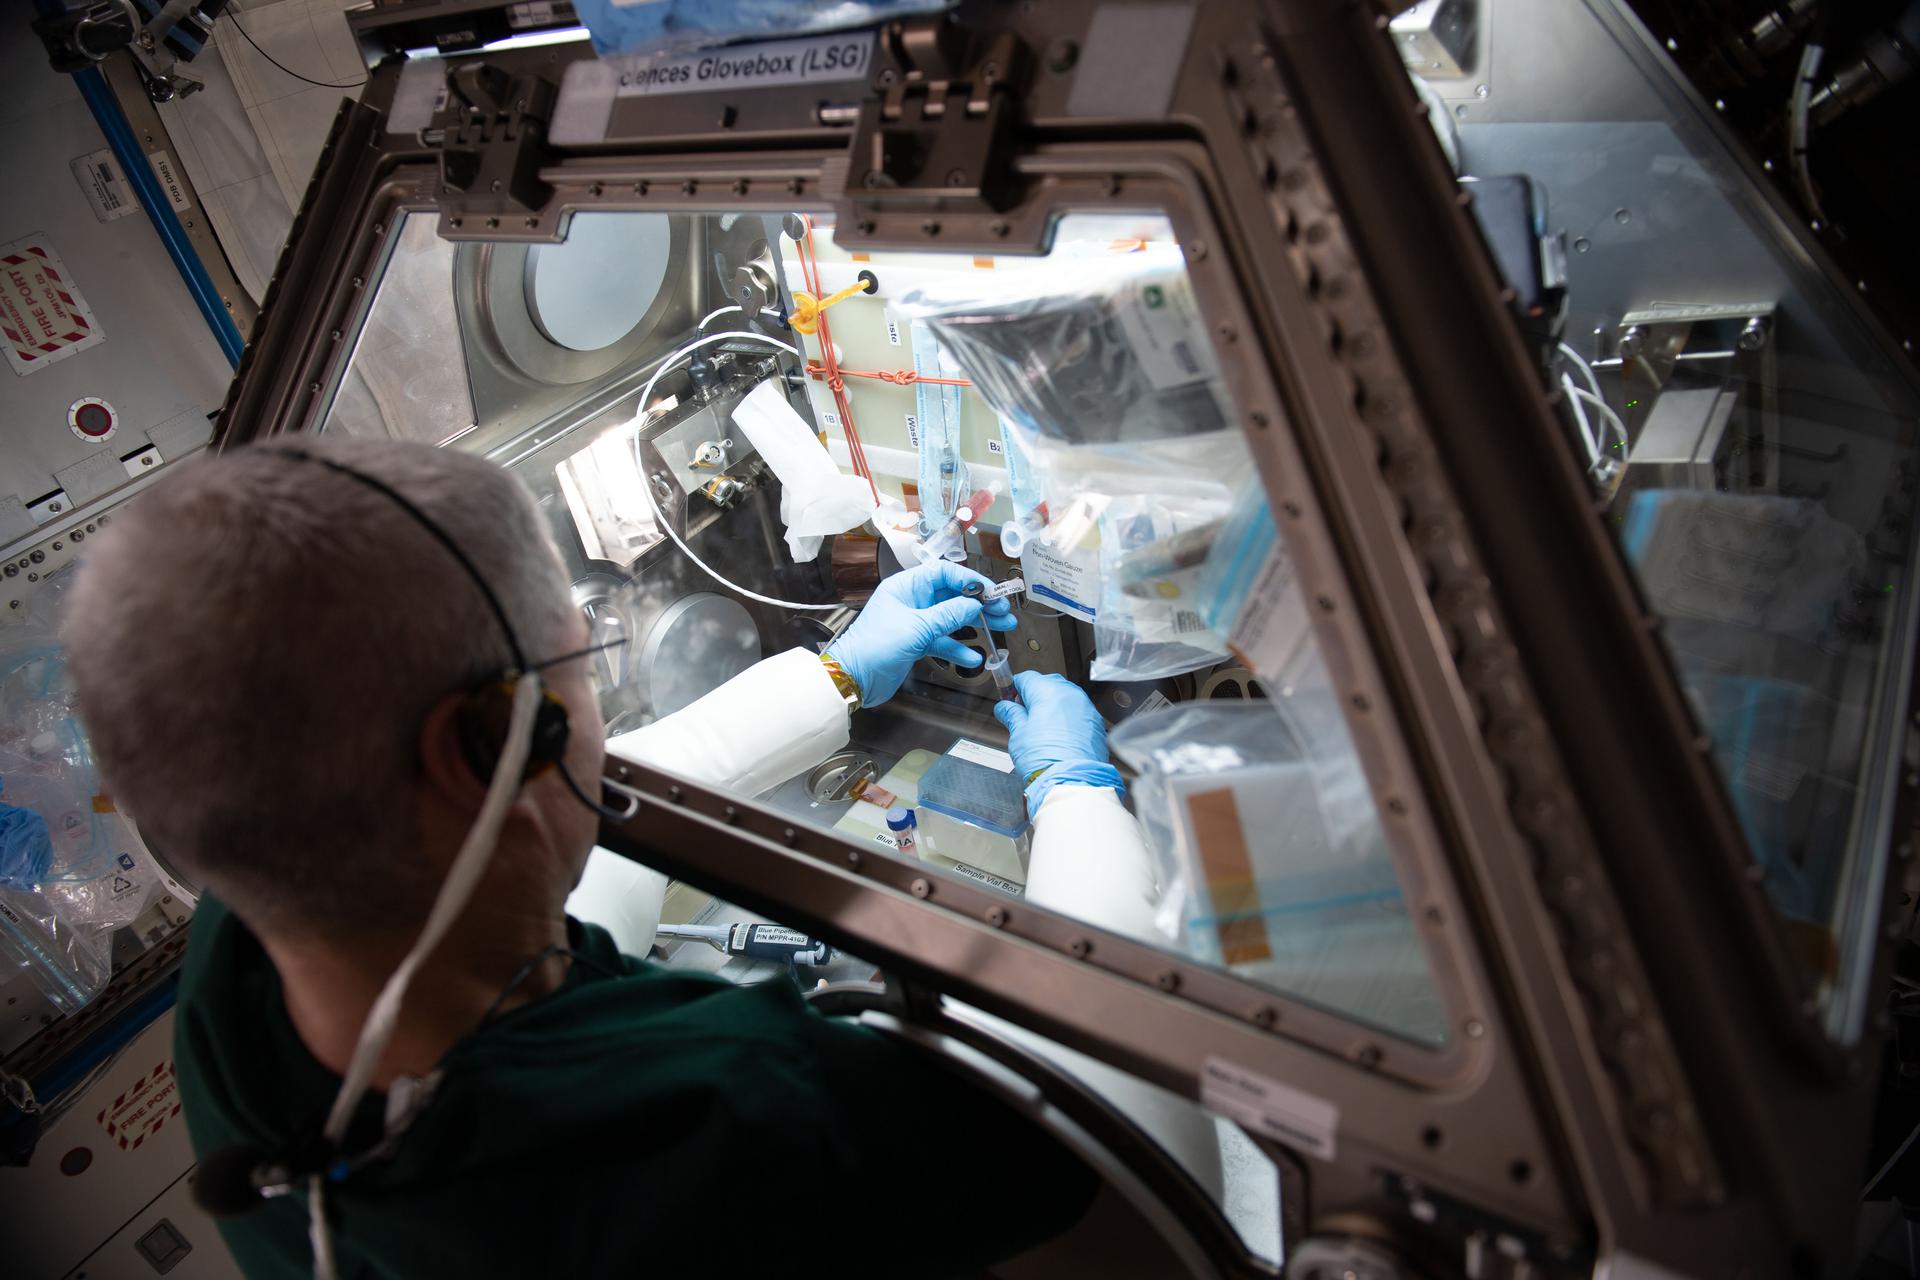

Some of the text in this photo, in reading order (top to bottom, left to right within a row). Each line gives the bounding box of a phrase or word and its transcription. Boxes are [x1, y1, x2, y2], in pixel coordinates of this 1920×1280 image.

[696, 53, 795, 82] Glovebox
[801, 43, 868, 77] (LSG)
[158, 160, 183, 204] PDB DMS1
[0, 296, 37, 346] EMERGENCY
[8, 270, 57, 338] FIRE PORT
[825, 414, 835, 424] 1B
[907, 417, 919, 447] Waste
[876, 834, 893, 846] Blue
[897, 838, 912, 847] 1A
[955, 864, 1018, 894] Sample Vial Box
[120, 1107, 147, 1131] FIRE
[147, 1082, 176, 1108] PORT
